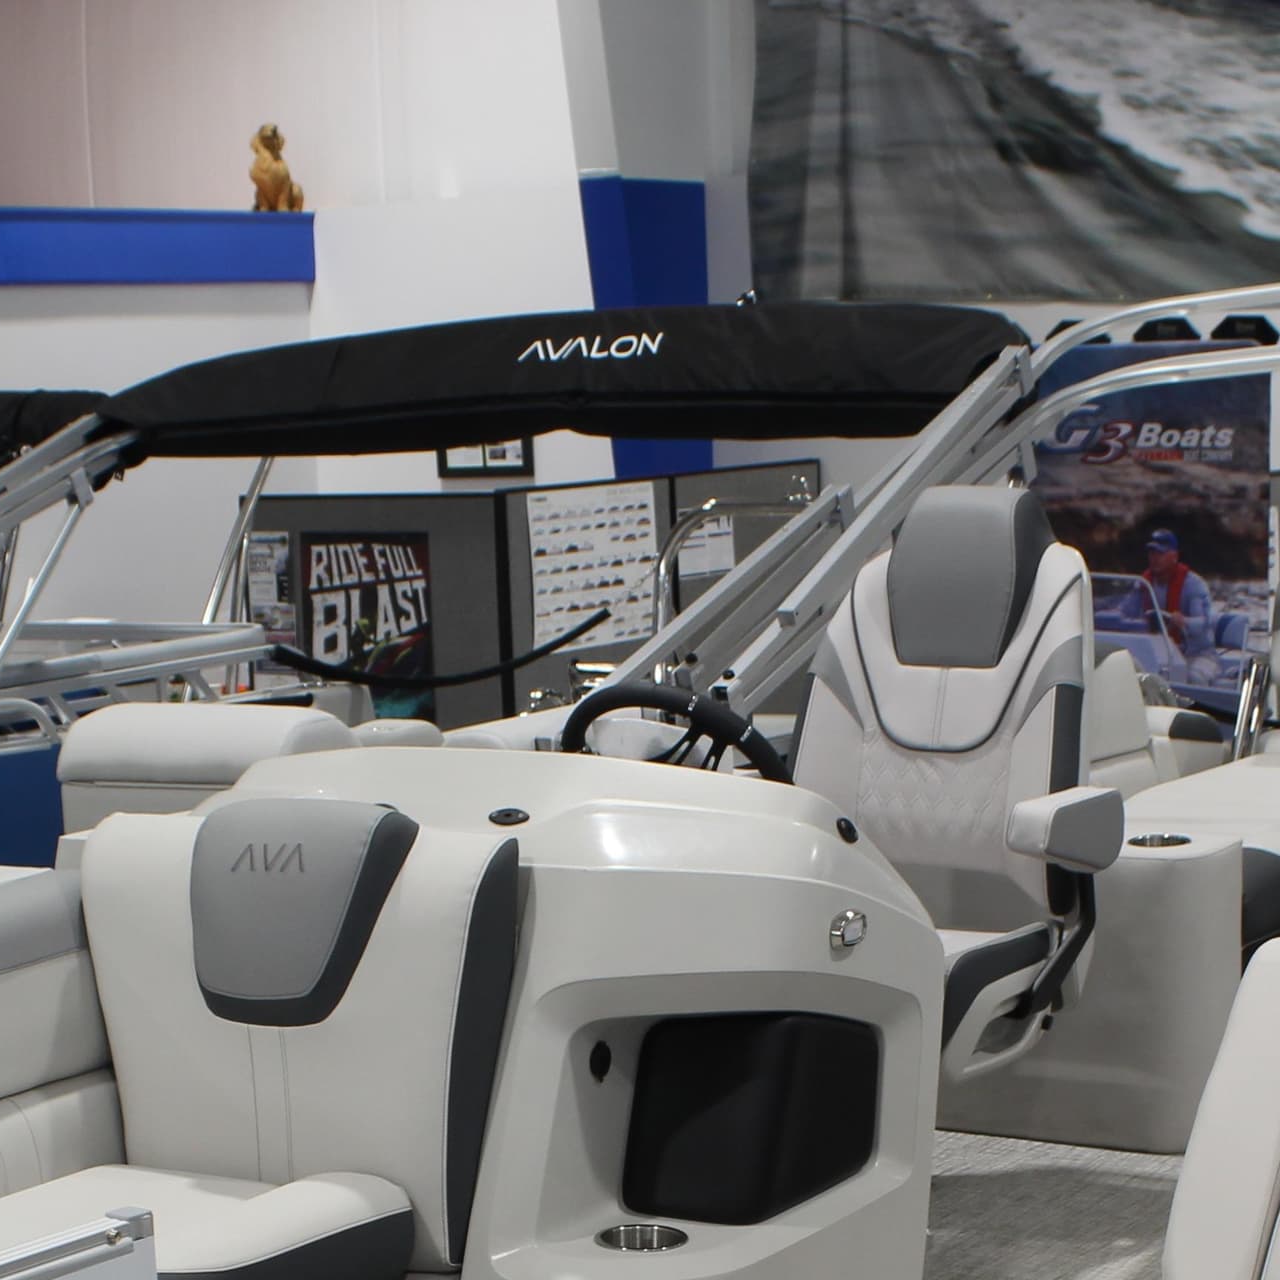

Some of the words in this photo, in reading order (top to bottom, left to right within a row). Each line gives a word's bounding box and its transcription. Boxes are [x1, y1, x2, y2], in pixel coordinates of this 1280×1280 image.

[517, 331, 664, 363] AVALON
[1135, 421, 1235, 450] Boats
[308, 543, 377, 591] RIDE
[371, 543, 423, 581] FULL
[230, 842, 304, 873] AVA
